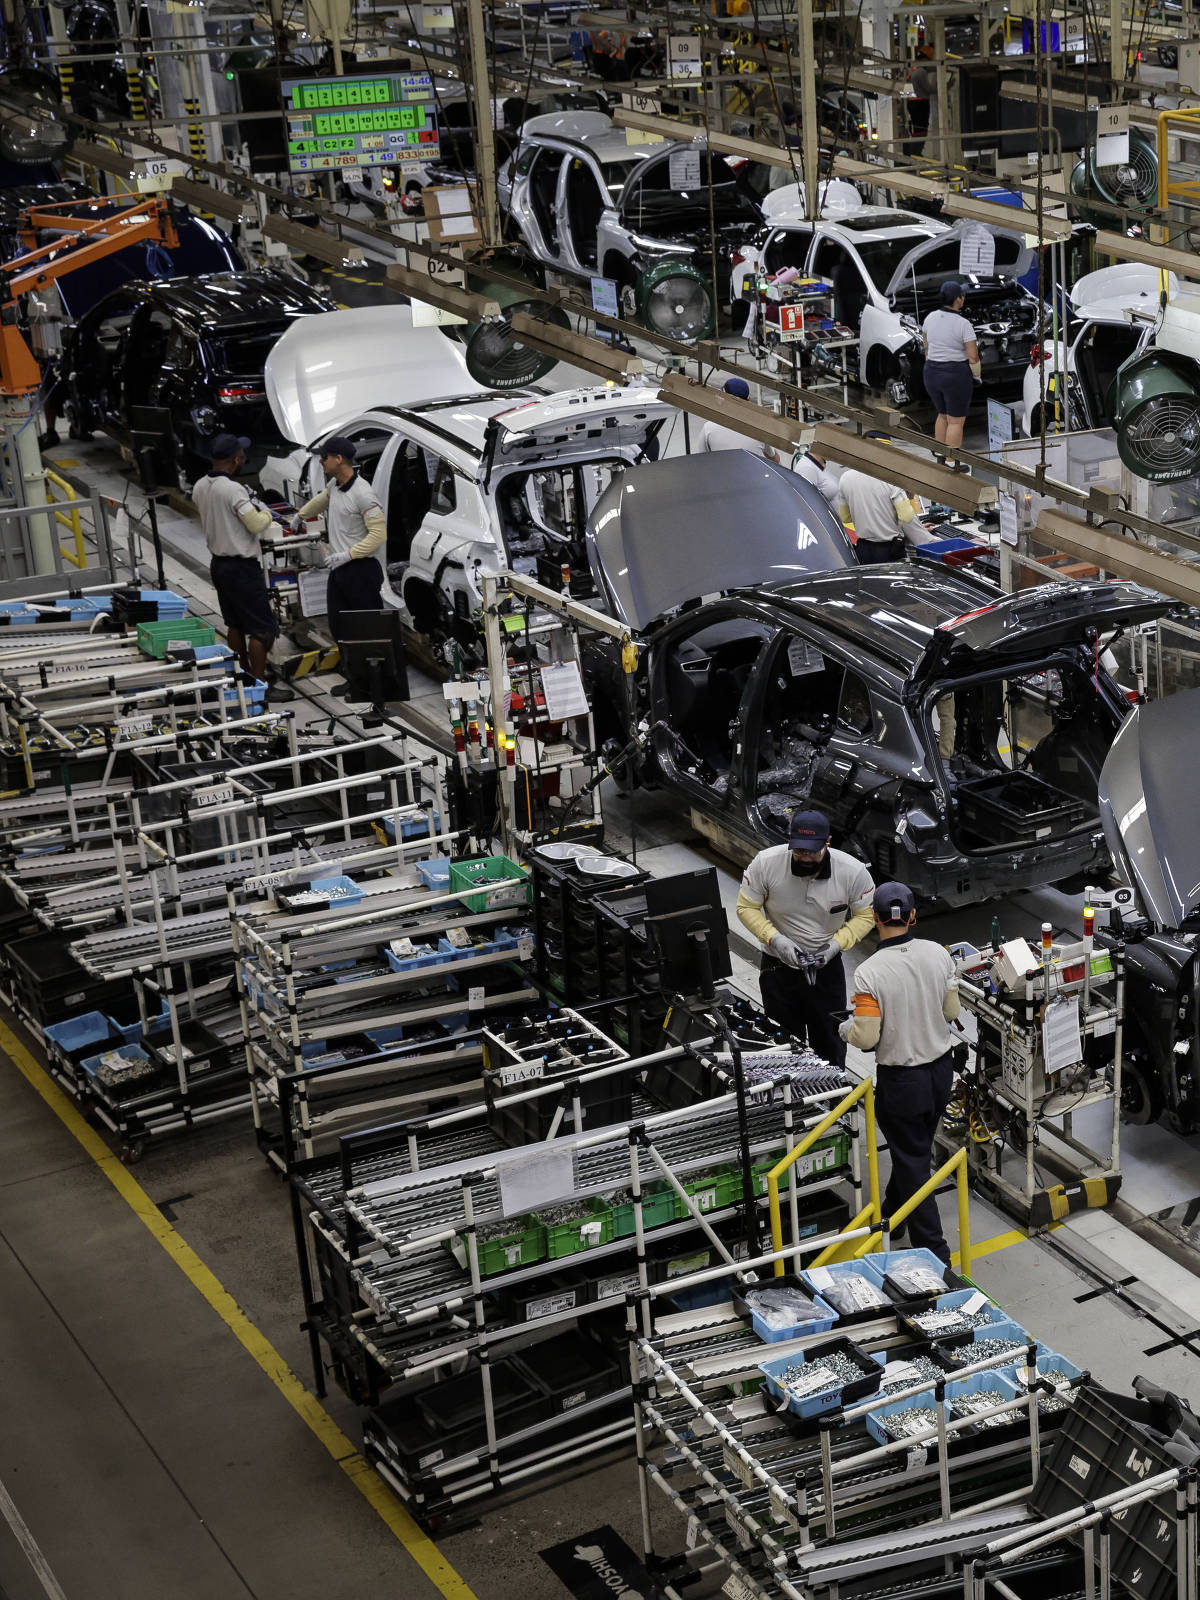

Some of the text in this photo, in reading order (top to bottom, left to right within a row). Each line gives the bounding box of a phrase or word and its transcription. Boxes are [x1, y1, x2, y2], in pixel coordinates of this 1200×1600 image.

[678, 43, 689, 52] 09
[678, 64, 689, 74] 36
[401, 76, 433, 87] 14:40
[350, 89, 358, 97] 4
[320, 119, 326, 127] 7
[361, 116, 372, 124] 10
[375, 115, 385, 123] 11
[402, 112, 413, 120] 13
[1108, 114, 1119, 125] 10
[296, 142, 305, 151] 4
[323, 139, 338, 149] C2
[340, 138, 354, 147] F2
[322, 158, 330, 166] 4
[335, 155, 356, 165] 789
[379, 153, 394, 161] 49
[152, 163, 168, 174] 05
[300, 160, 307, 169] 5
[428, 260, 446, 274] 02
[55, 664, 86, 674] F1A-16
[120, 722, 152, 734] F1A-12
[199, 789, 232, 805] F1A-11
[244, 876, 280, 891] F1A-08
[504, 1066, 542, 1084] F1A-07
[589, 1557, 630, 1595] YOSHI
